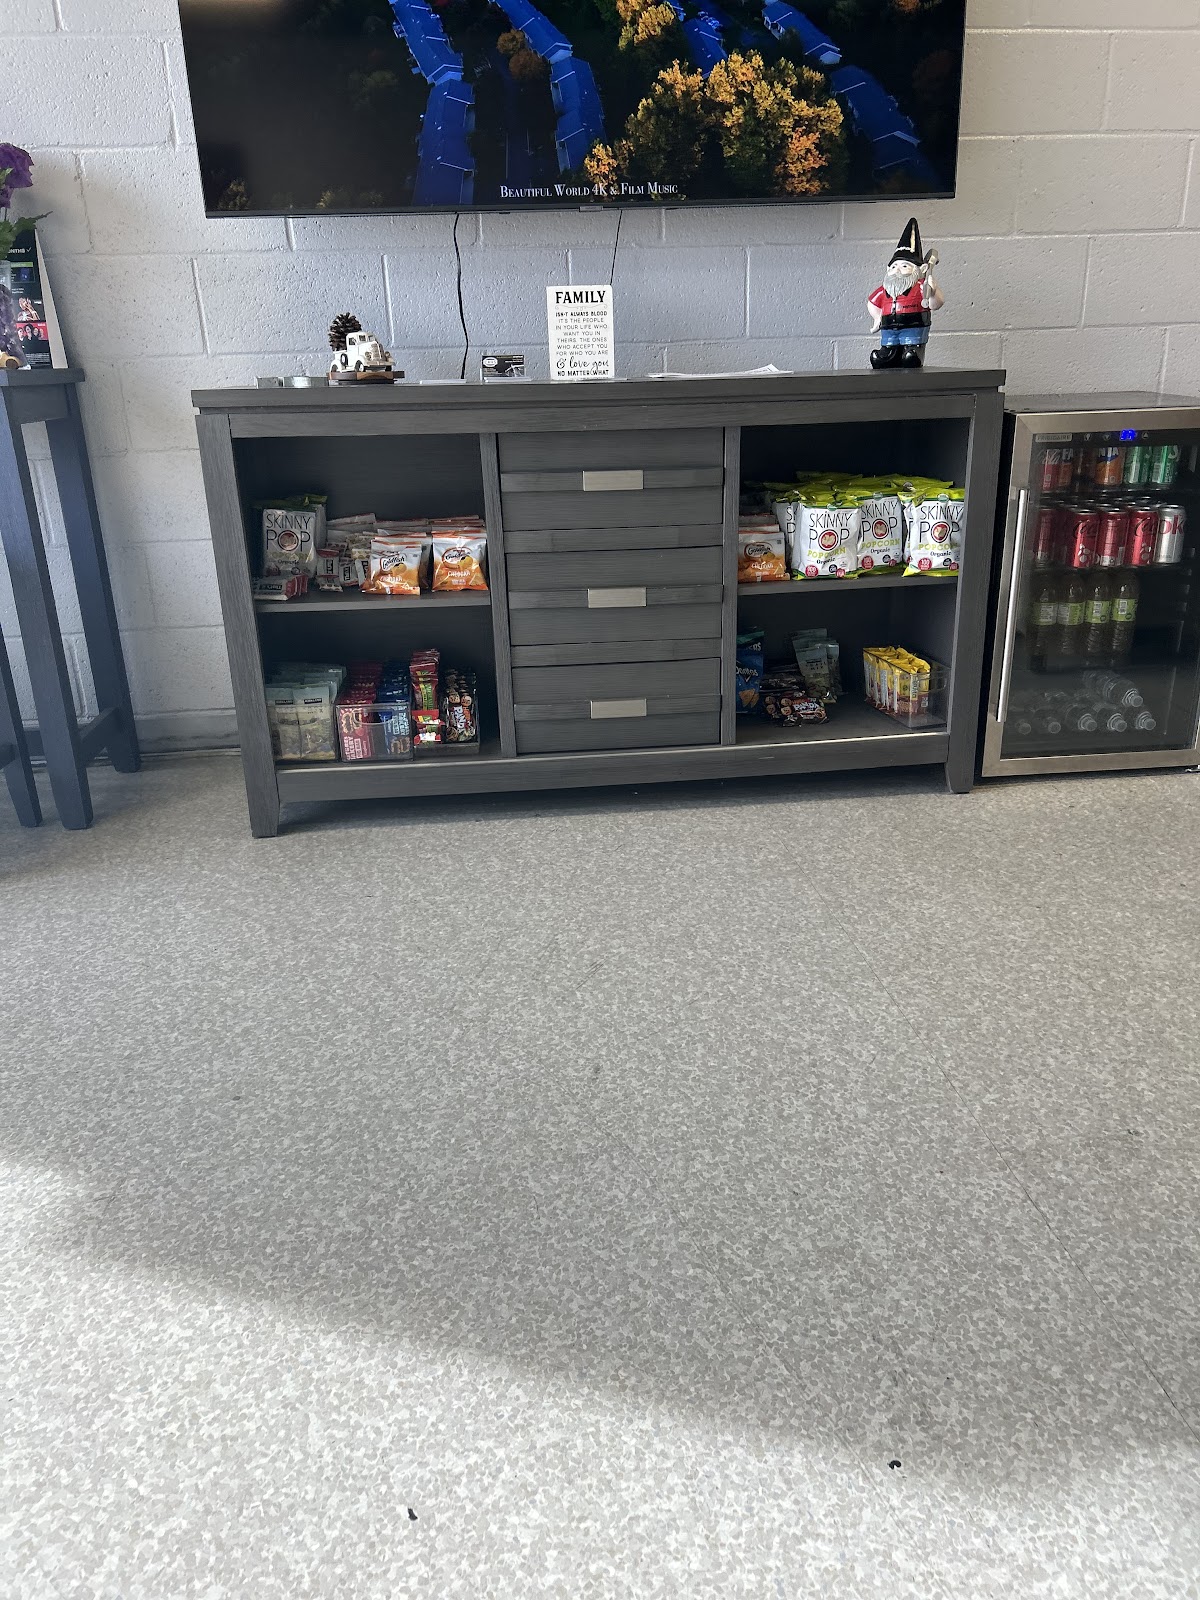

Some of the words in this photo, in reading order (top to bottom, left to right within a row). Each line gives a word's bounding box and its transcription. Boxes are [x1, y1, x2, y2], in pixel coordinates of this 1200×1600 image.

[555, 290, 606, 304] FAMILY
[569, 355, 591, 369] love
[590, 359, 609, 376] you
[808, 510, 853, 529] SKINNY
[860, 501, 899, 520] SKINNY
[920, 502, 965, 521] SKINNY
[266, 513, 312, 530] SKINNY
[861, 516, 898, 542] POP
[266, 529, 311, 552] POP
[808, 528, 850, 551] POP
[919, 521, 960, 543] POP
[807, 547, 846, 559] POPCORN
[861, 539, 900, 550] POPCORN
[870, 547, 891, 555] Organic
[382, 556, 405, 570] Goldfish
[816, 557, 835, 566] Organic
[930, 550, 952, 558] Organic
